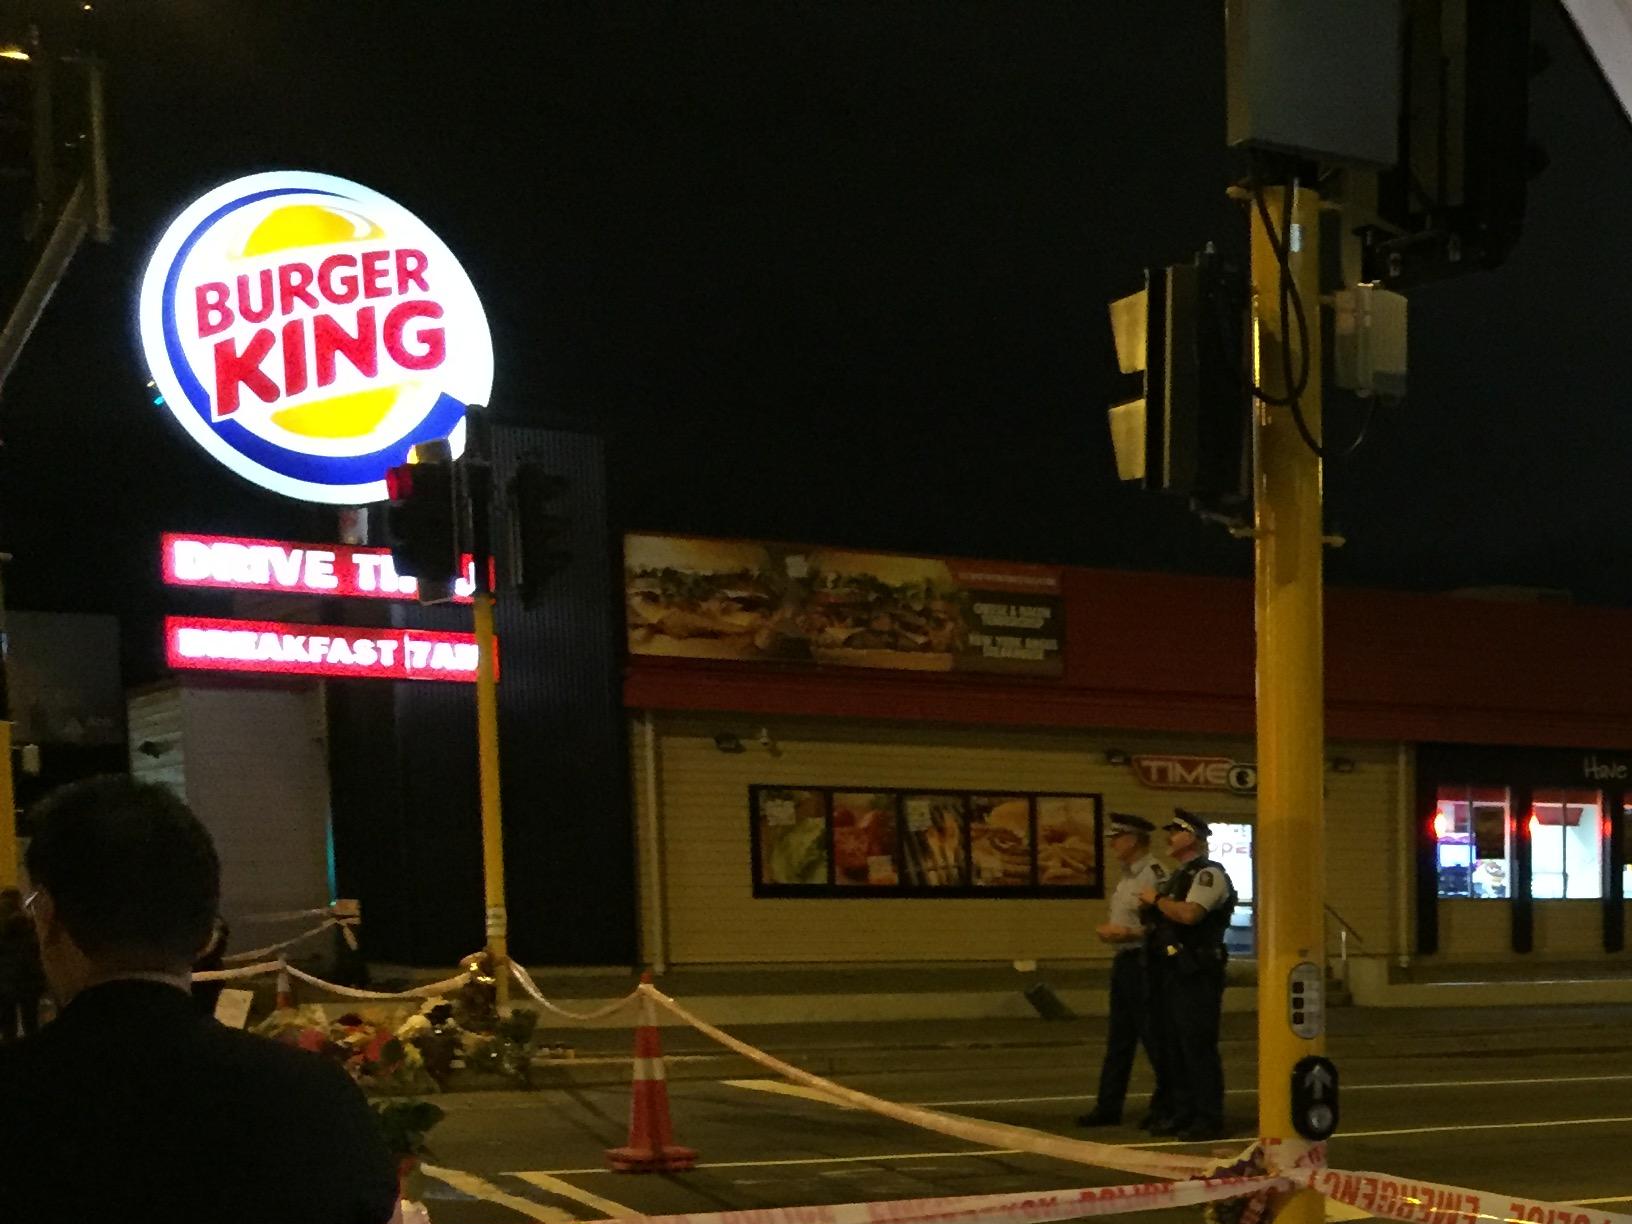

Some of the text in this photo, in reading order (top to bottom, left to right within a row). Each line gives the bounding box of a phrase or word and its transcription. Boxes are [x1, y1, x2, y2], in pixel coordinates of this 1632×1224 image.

[195, 249, 430, 338] BURGER
[212, 300, 447, 417] KING
[173, 540, 339, 589] DRIVE
[178, 628, 398, 667] BREAKFAST
[1584, 753, 1628, 780] Have
